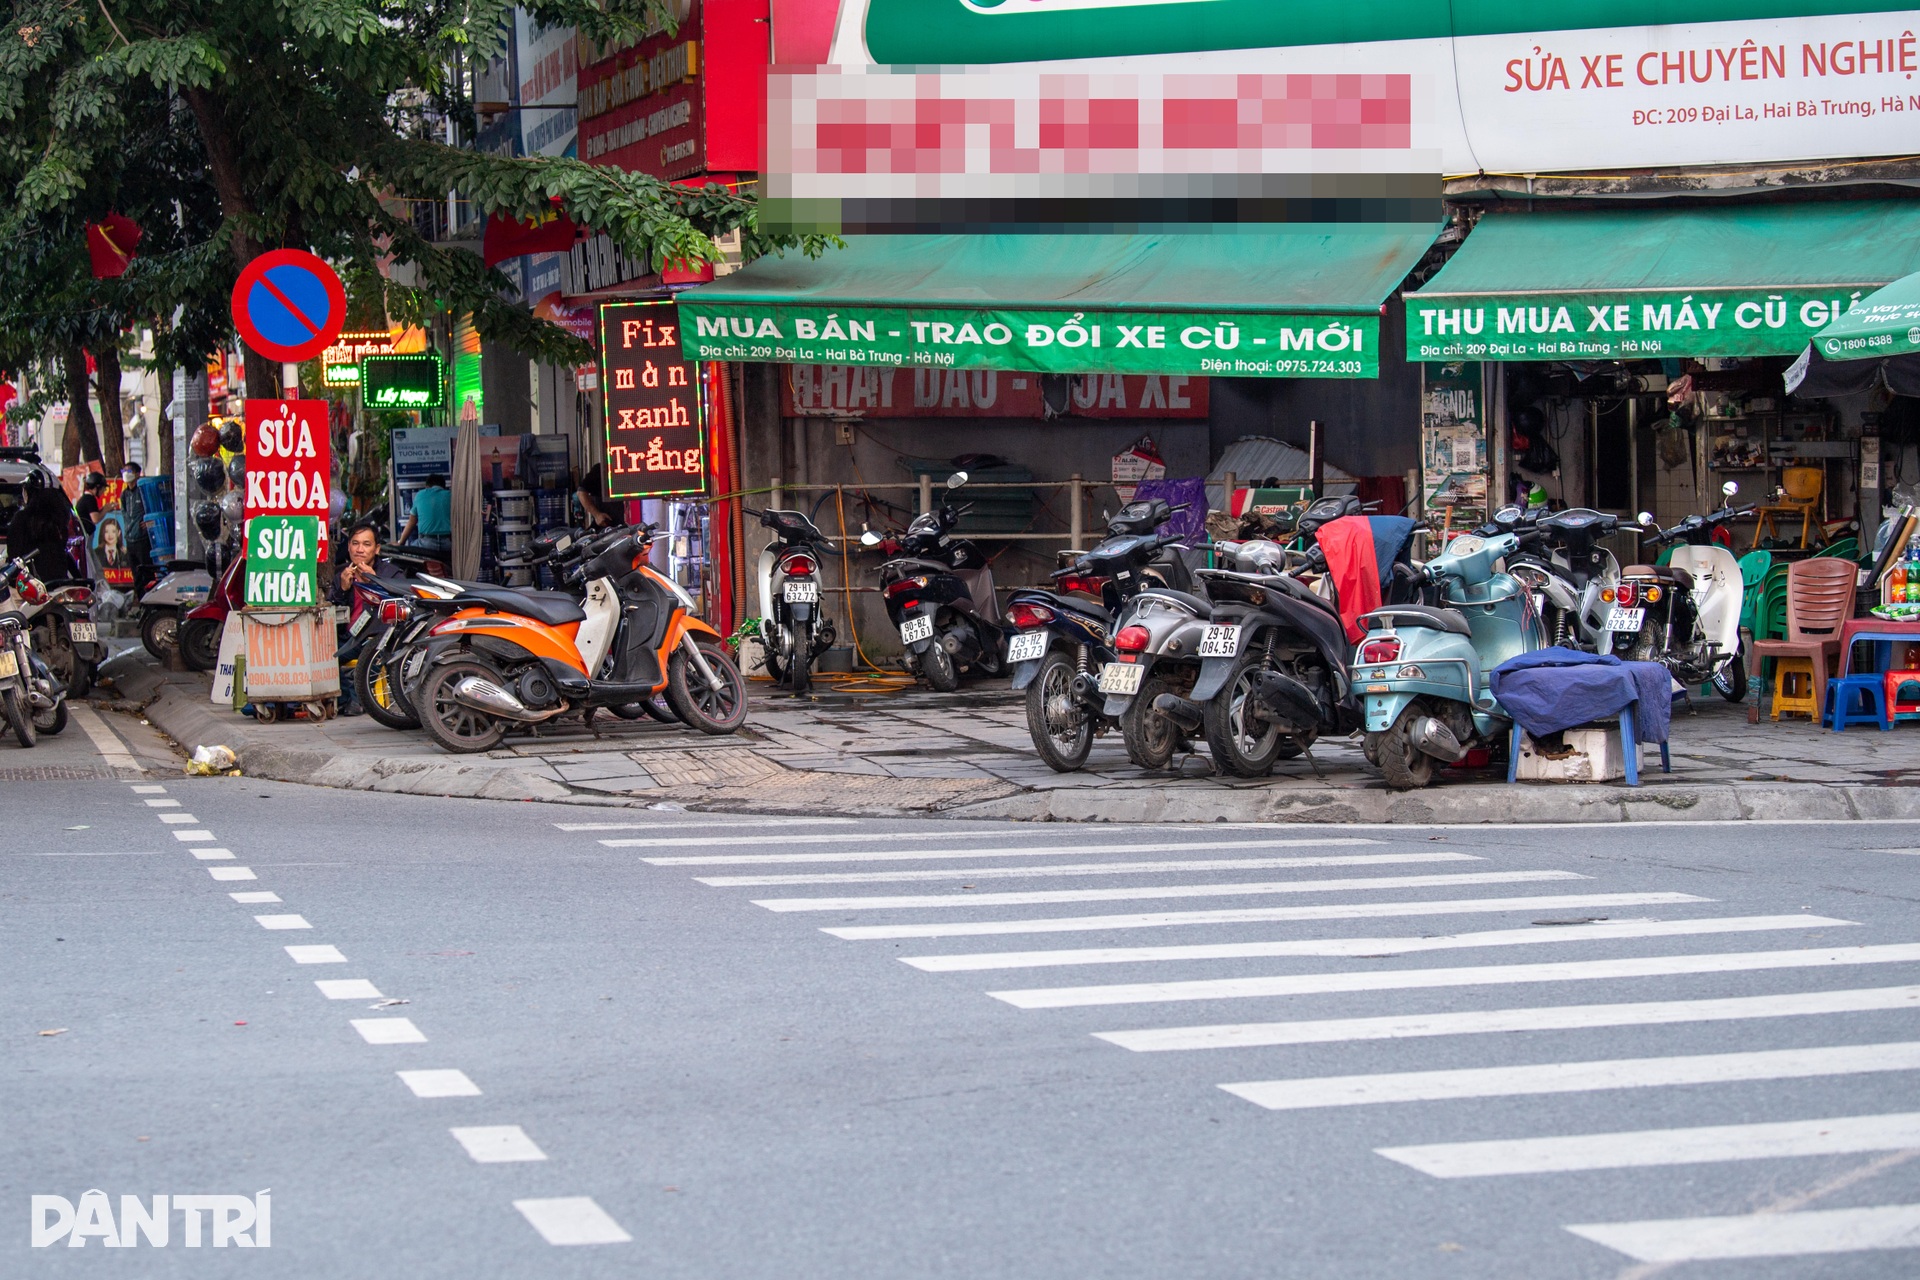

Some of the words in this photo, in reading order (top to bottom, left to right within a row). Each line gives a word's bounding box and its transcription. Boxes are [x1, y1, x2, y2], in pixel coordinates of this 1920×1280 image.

[1504, 45, 1570, 92] SỬA
[1580, 54, 1624, 89] XE
[1637, 39, 1786, 86] CHUYÊN
[1632, 109, 1663, 126] ĐC:
[1667, 108, 1698, 124] 209
[1702, 105, 1731, 126] Đại
[1735, 104, 1760, 123] La,
[1764, 101, 1791, 118] Hai
[1796, 99, 1817, 117] Bà
[1821, 98, 1877, 119] Trưng,
[1881, 95, 1904, 112] Hà
[1420, 308, 1485, 335] THU
[1497, 306, 1576, 334] MUA
[1587, 304, 1631, 332] XE
[1643, 294, 1723, 332] MÁY
[1734, 295, 1788, 329] CŨ
[1799, 291, 1861, 327] GI
[622, 320, 676, 348] Fix
[696, 316, 783, 338] MUA
[795, 313, 875, 341] BÁN
[910, 321, 1012, 345] TRAO
[1025, 312, 1100, 347] ĐỔI
[1116, 325, 1165, 348] XE
[1180, 322, 1239, 349] CŨ
[1280, 322, 1362, 351] MỚI
[1420, 345, 1445, 357] Địa
[1447, 343, 1464, 356] chỉ:
[1466, 343, 1486, 355] 209
[1489, 343, 1509, 357] Đại
[1511, 343, 1526, 354] La
[1538, 341, 1557, 353] Hai
[1560, 341, 1576, 353] Bà
[1578, 341, 1610, 356] Trưng
[1621, 340, 1638, 352] Hà
[1641, 339, 1662, 354] Nội
[1842, 338, 1866, 350] 1800
[1868, 335, 1892, 346] 6388
[699, 345, 722, 357] Địa
[725, 344, 748, 357] chỉ:
[750, 346, 772, 357] 209
[775, 347, 796, 359] Đại
[800, 347, 814, 359] La
[825, 349, 846, 360] Hai
[850, 349, 866, 361] Bà
[868, 350, 902, 365] Trưng
[914, 351, 931, 364] Hà
[934, 352, 954, 365] Nội
[1201, 359, 1231, 373] Điện
[1234, 359, 1272, 375] thoại:
[1276, 360, 1361, 373] 0975.724.303
[1139, 374, 1191, 408] XE
[617, 398, 690, 430] xanh
[258, 404, 317, 458] SỬA
[609, 436, 700, 474] Trắng
[246, 461, 329, 509] KHÓA
[257, 519, 306, 560] SỬA
[248, 564, 312, 603] KHÓA
[789, 583, 812, 592] 29-H1
[786, 592, 815, 601] 632.72
[1613, 609, 1638, 619] 29-AA
[1207, 627, 1235, 640] 29-D2
[1607, 620, 1639, 630] 828.23
[248, 614, 305, 667] KHÓA
[1014, 634, 1041, 646] 29-H2
[1201, 641, 1235, 654] 084.56
[1009, 646, 1043, 660] 283.73
[248, 672, 309, 686] 0904.438.034
[1108, 666, 1136, 678] 29-AA
[1102, 678, 1136, 692] 329.41
